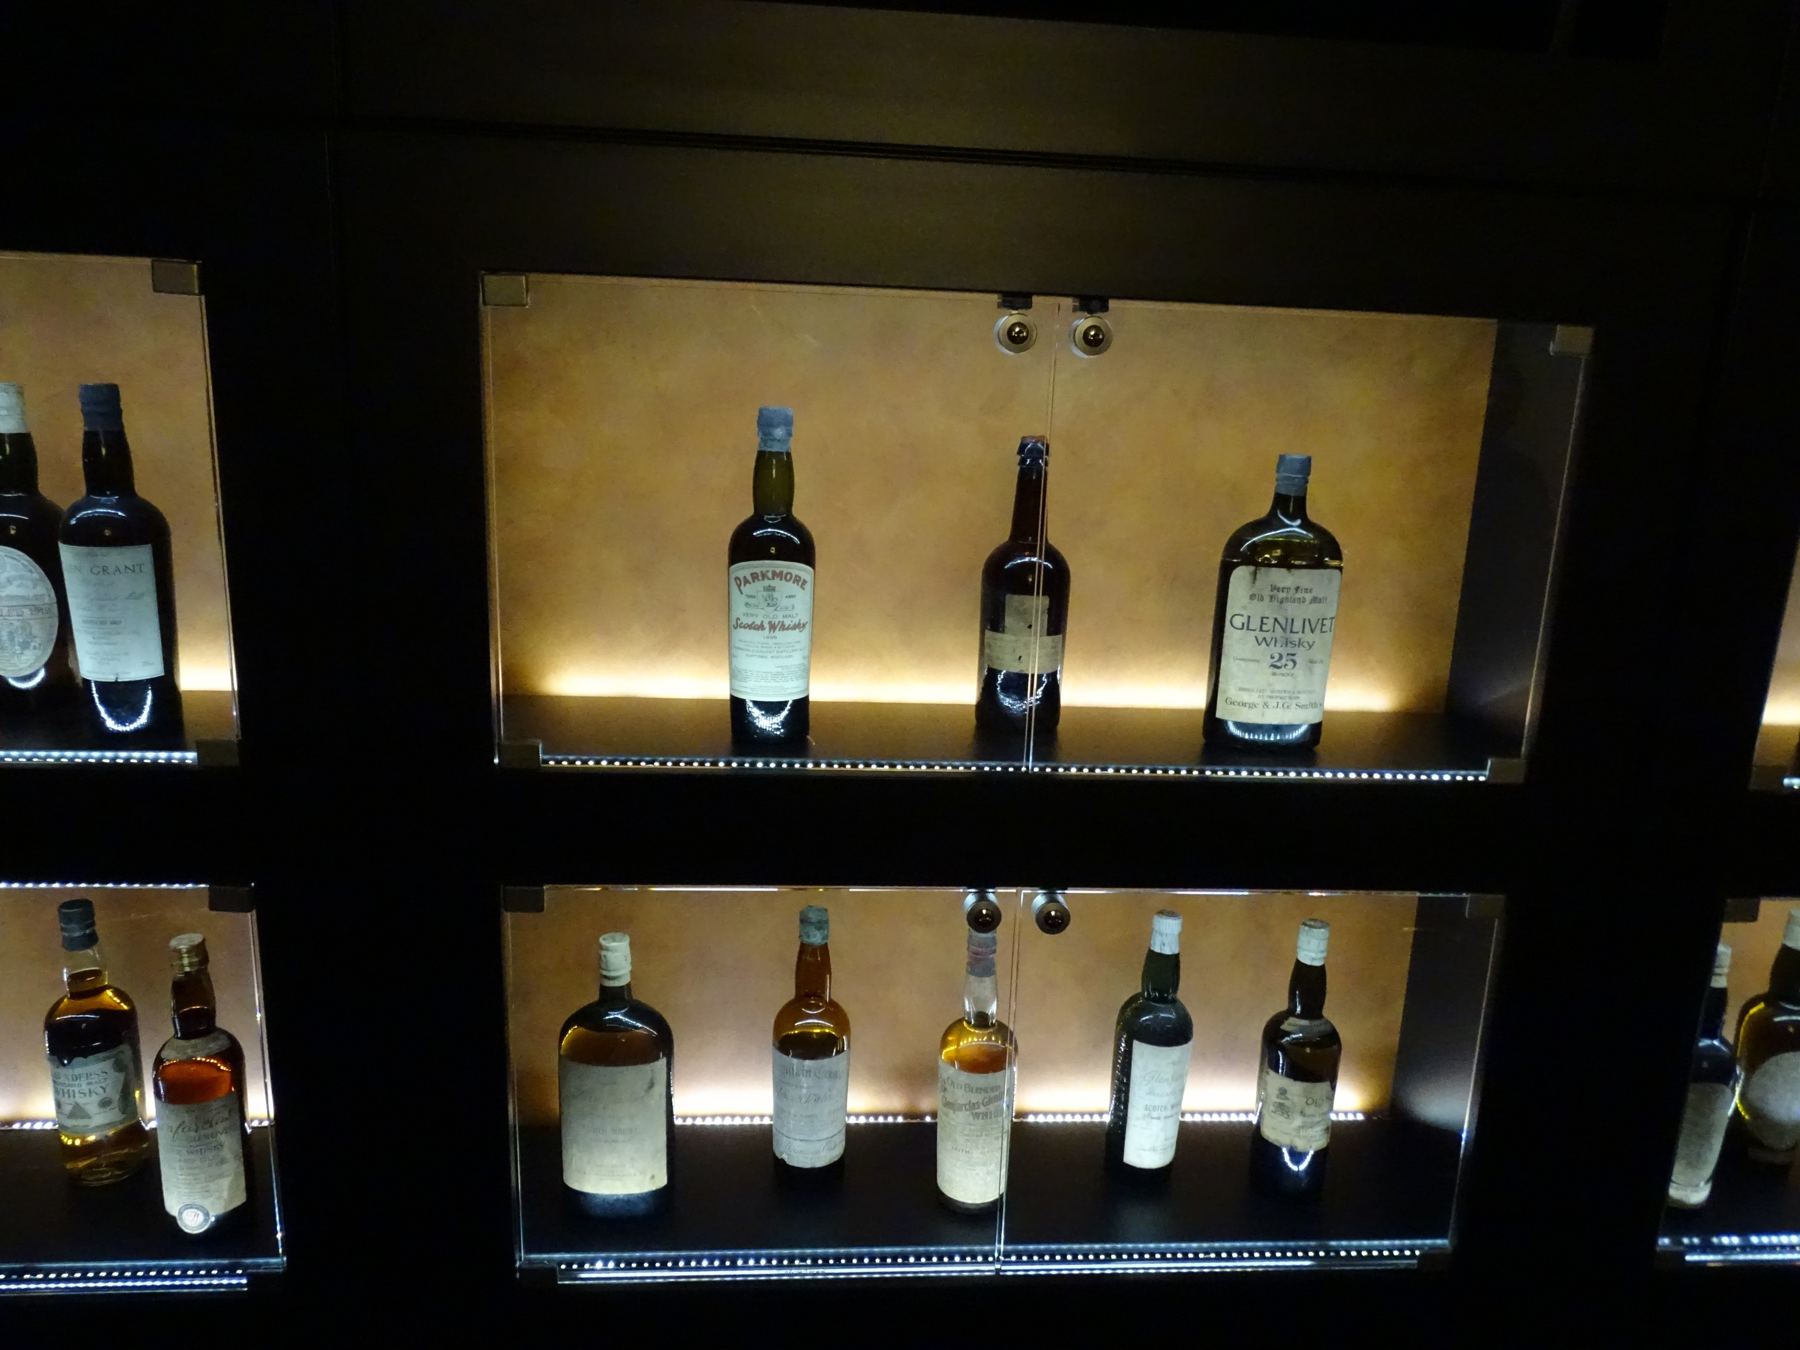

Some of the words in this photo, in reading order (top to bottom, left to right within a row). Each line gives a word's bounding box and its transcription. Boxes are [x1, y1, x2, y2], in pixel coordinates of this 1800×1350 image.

[90, 563, 145, 576] GRANT
[734, 569, 808, 594] PARKMORE
[1249, 593, 1265, 602] Old
[1269, 595, 1307, 605] Highland
[733, 618, 766, 630] Scotch
[767, 619, 808, 634] Whisky
[1229, 613, 1335, 634] GLENLIVET
[1269, 652, 1297, 671] 25
[1225, 696, 1260, 710] George
[1262, 701, 1270, 709] &
